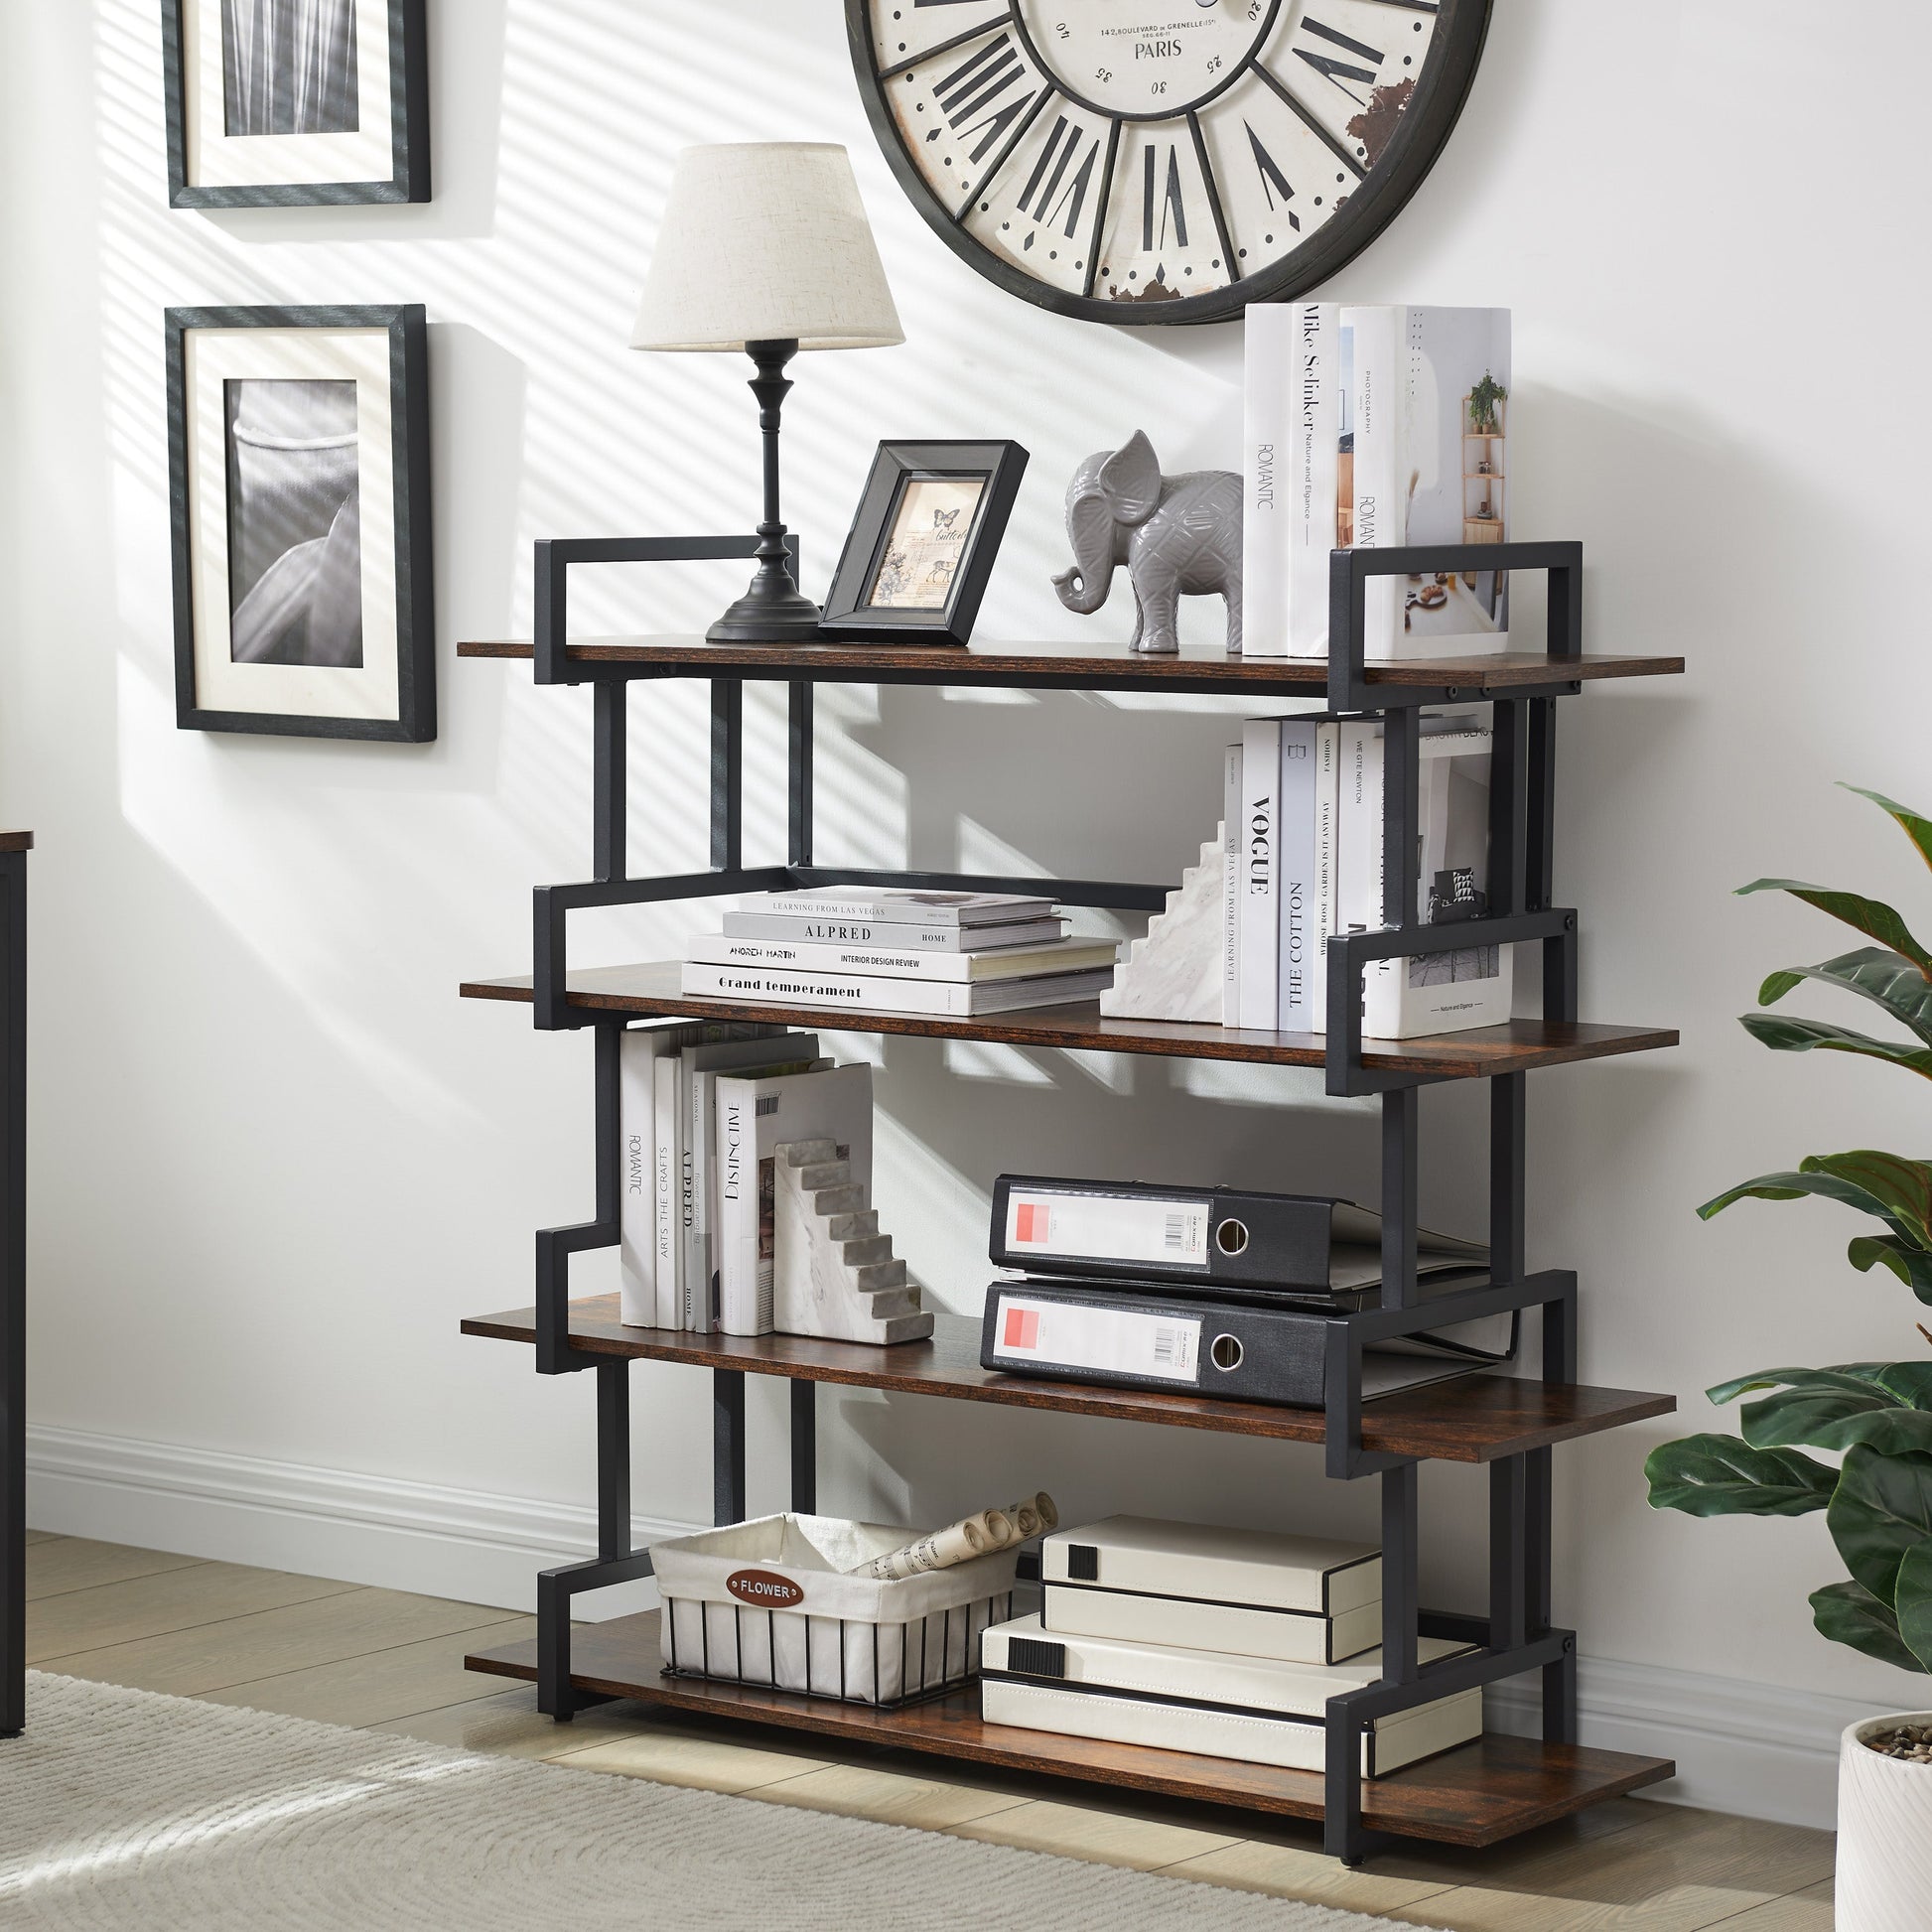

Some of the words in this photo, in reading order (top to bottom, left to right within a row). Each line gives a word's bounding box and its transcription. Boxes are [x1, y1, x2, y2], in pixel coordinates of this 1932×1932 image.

[1055, 22, 1070, 40] 40
[1135, 39, 1182, 60] PARIS
[1206, 55, 1223, 73] 25
[1095, 68, 1113, 83] 35
[1151, 81, 1168, 94] 30
[1304, 305, 1319, 347] Mike
[1304, 354, 1319, 431] Selinker
[1257, 444, 1274, 509] ROMANTIC
[1356, 740, 1363, 753] WE
[1251, 797, 1270, 895] VOGUE
[772, 902, 814, 911] LEARNING
[816, 904, 838, 913] FROM
[859, 907, 886, 916] VEGAS
[805, 925, 871, 940] ALPRED
[1290, 882, 1302, 963] COTTON
[840, 955, 870, 964] INTERIOR
[871, 957, 895, 966] DESIGN
[895, 959, 920, 968] REVIEW
[719, 977, 760, 990] Grand
[766, 980, 861, 998] temperament
[1290, 969, 1302, 1008] THE
[628, 1135, 641, 1195] ROMANTIC
[683, 1150, 692, 1227] ALPRED
[741, 1580, 790, 1598] FLOWER
